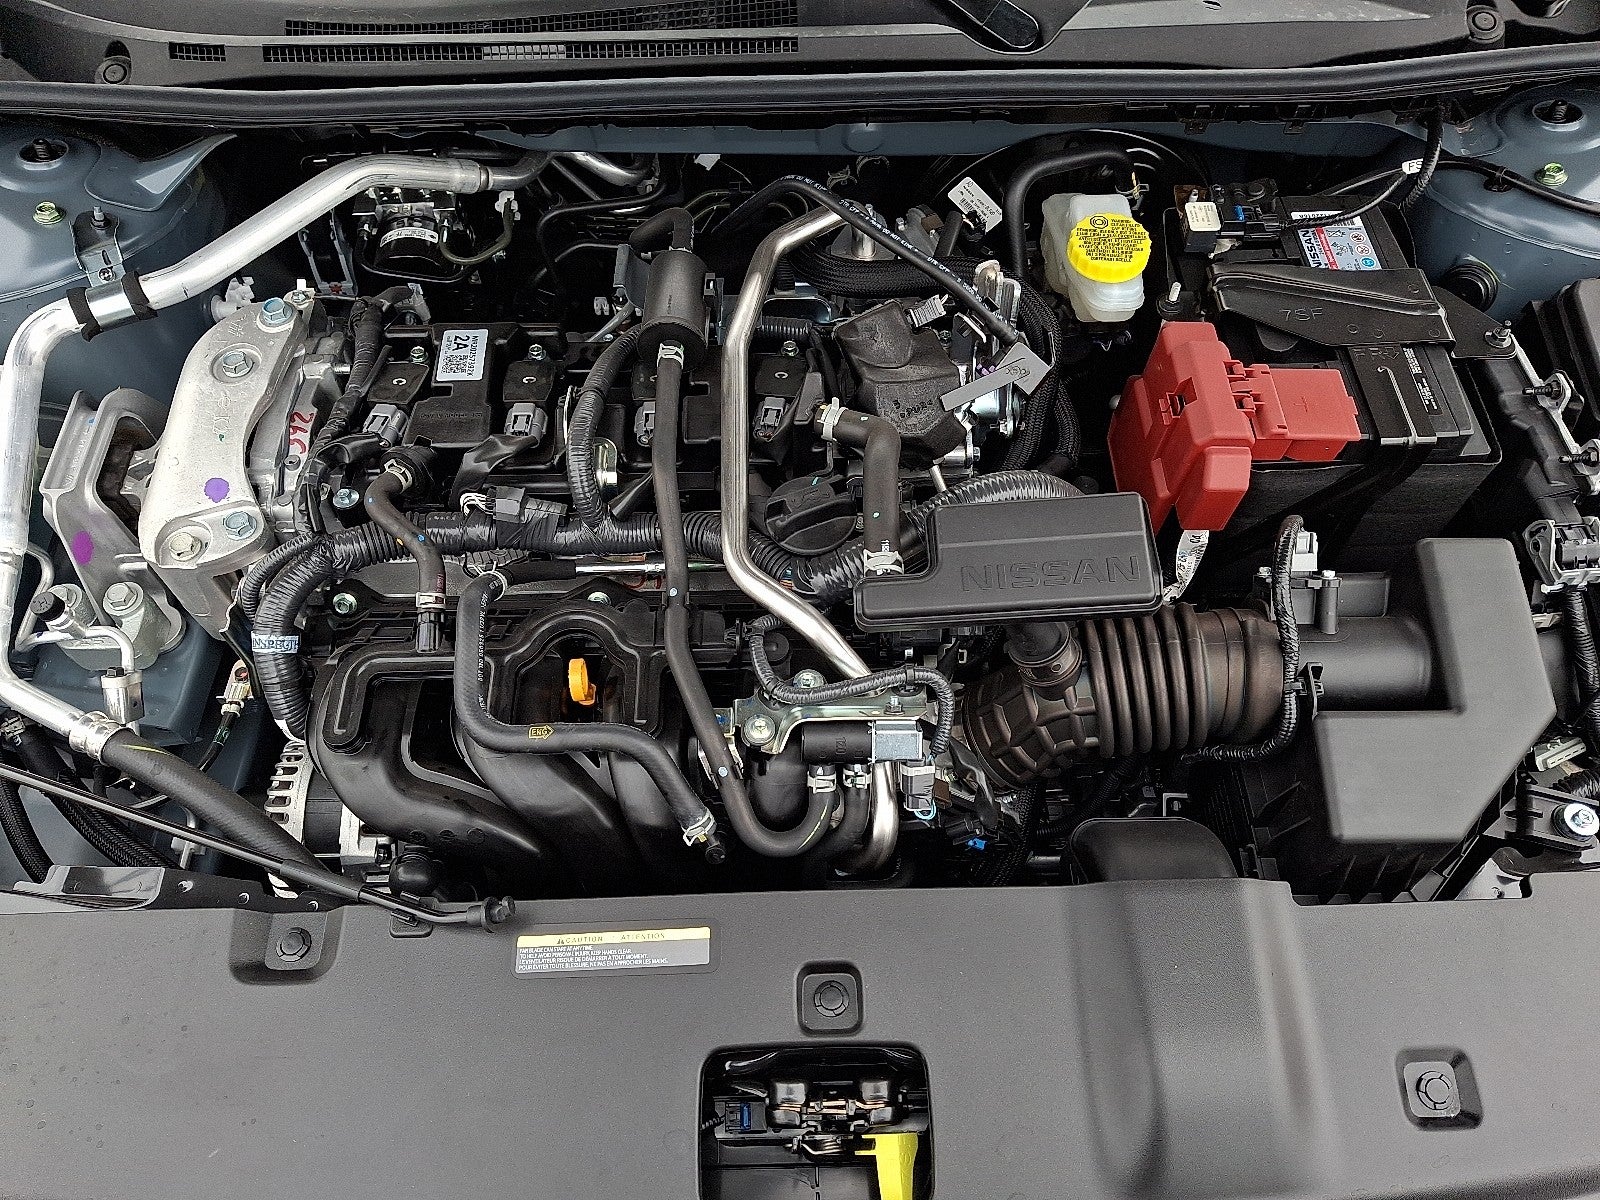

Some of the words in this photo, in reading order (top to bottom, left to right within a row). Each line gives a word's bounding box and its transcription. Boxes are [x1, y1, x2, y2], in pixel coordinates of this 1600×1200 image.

[452, 334, 470, 352] 2A
[961, 556, 1141, 592] NISSAN
[531, 728, 548, 736] ENG
[565, 936, 604, 944] CAUTION
[620, 932, 665, 941] ATTENTION
